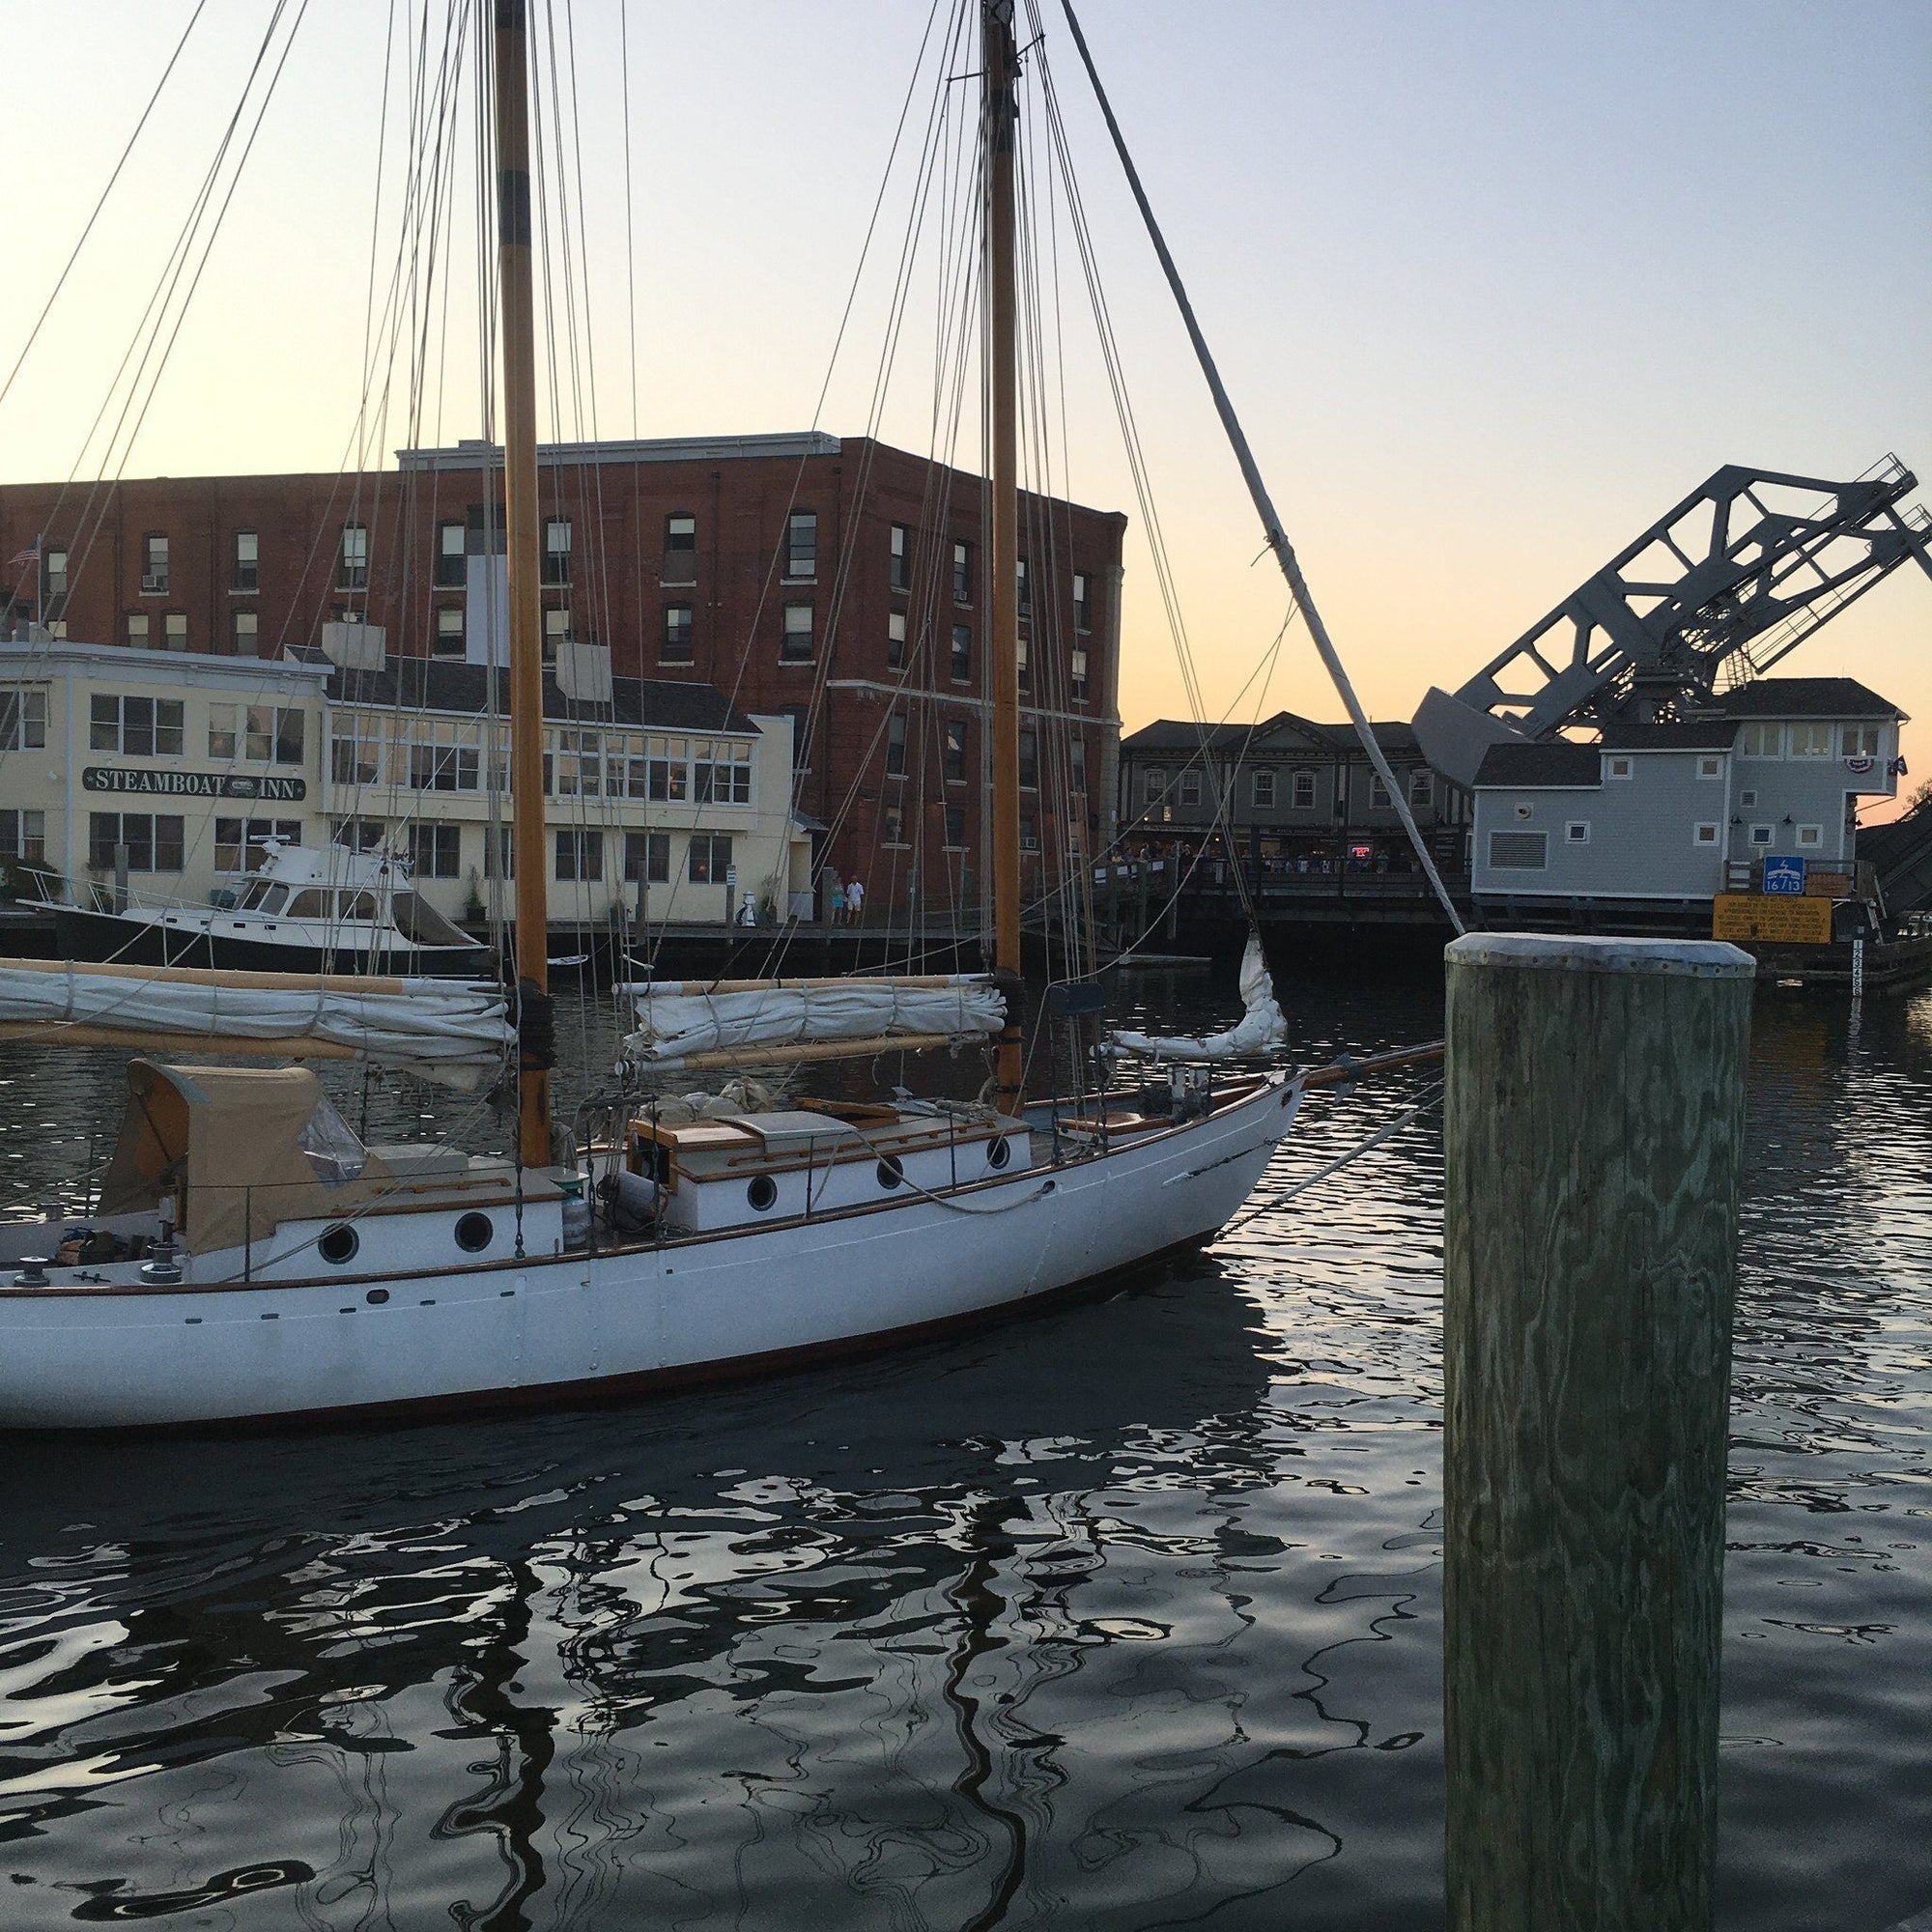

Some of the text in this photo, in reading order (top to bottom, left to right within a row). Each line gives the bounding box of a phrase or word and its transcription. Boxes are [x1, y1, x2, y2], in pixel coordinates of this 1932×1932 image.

[96, 769, 296, 799] STEAMBOAT INN
[1767, 881, 1800, 891] 16 13
